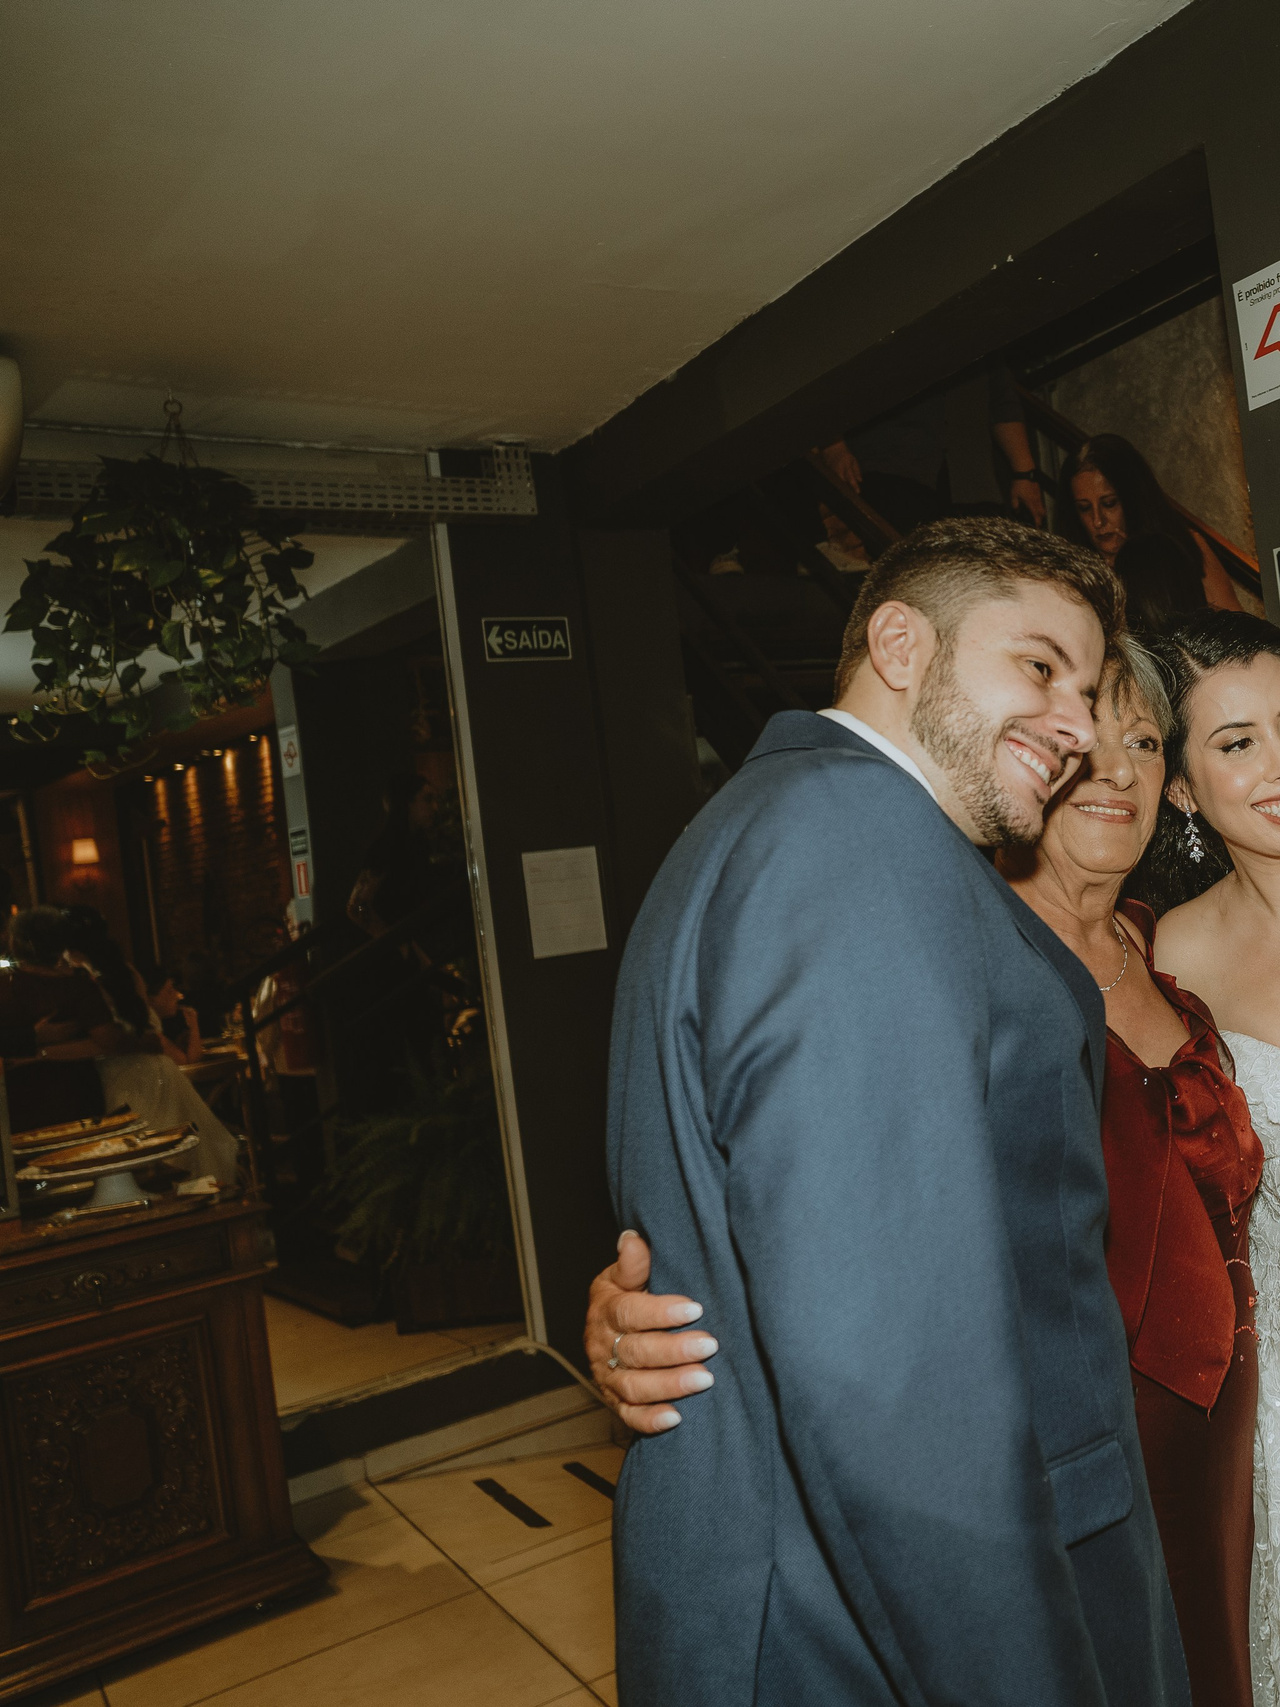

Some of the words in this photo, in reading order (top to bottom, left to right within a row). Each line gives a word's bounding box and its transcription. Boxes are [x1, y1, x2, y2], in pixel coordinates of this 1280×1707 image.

[1237, 290, 1244, 302] É
[1245, 276, 1275, 300] proibido
[1249, 291, 1272, 306] Smoking
[504, 624, 566, 650] SAÍDA
